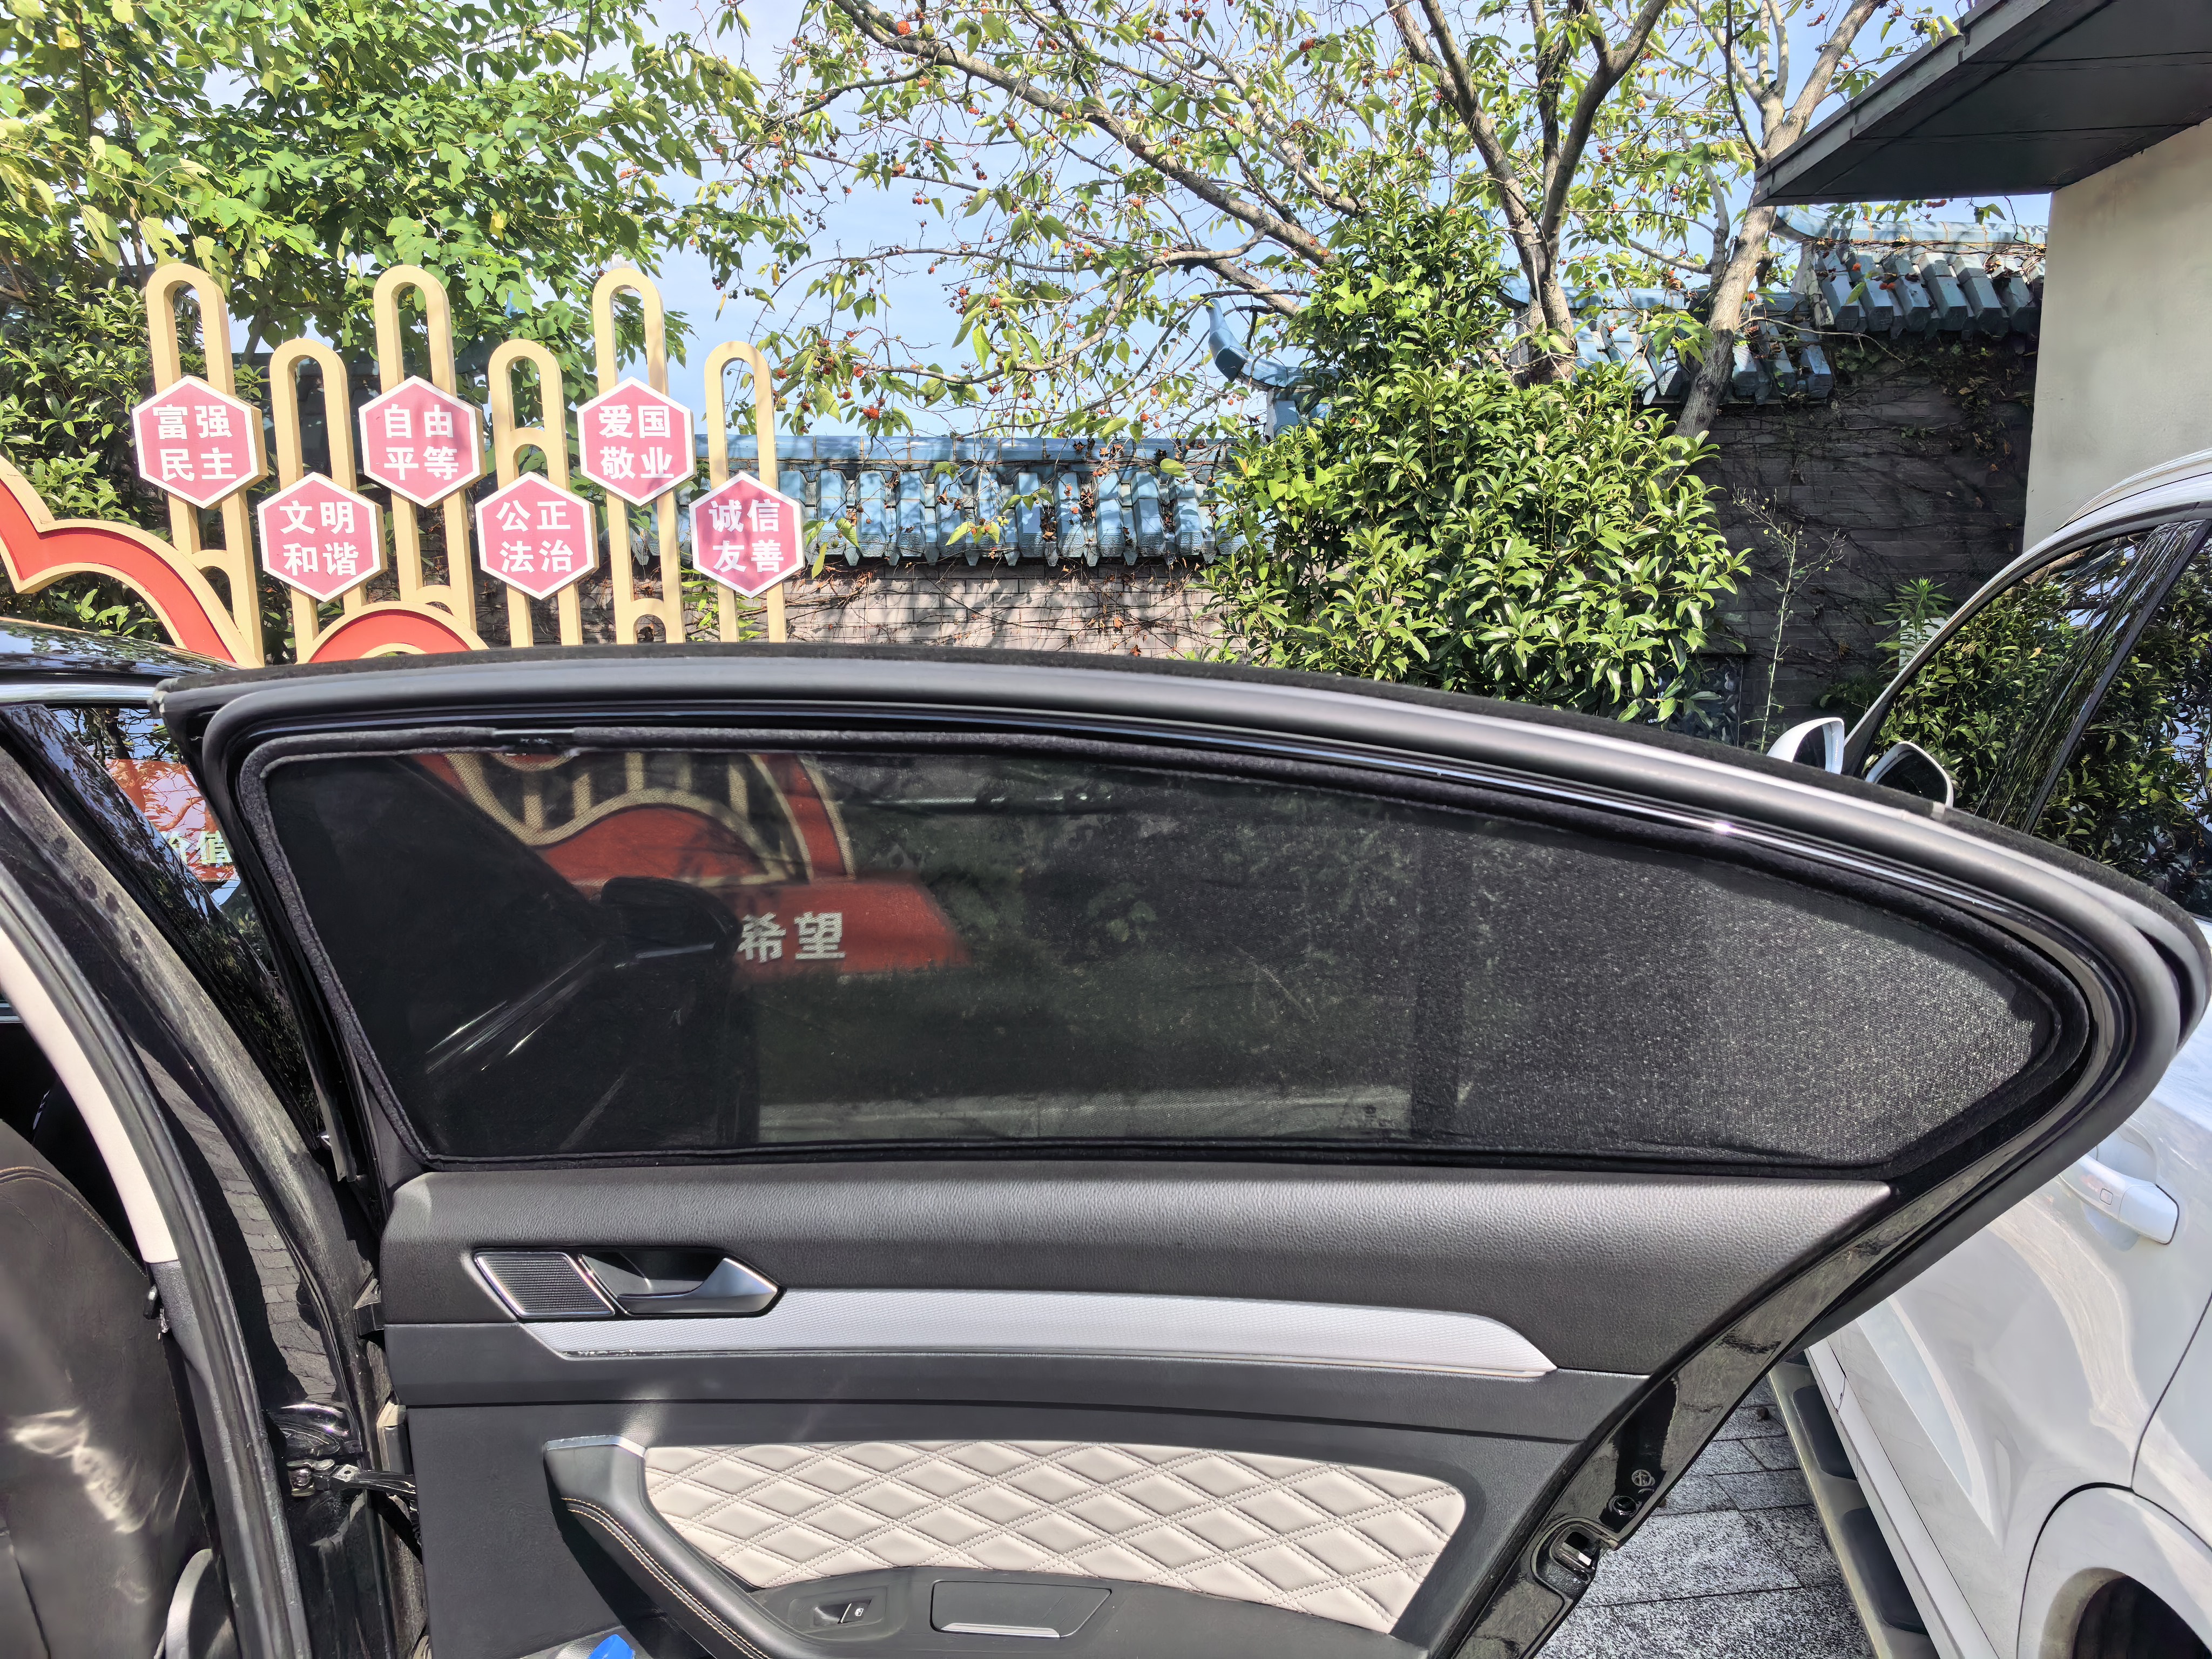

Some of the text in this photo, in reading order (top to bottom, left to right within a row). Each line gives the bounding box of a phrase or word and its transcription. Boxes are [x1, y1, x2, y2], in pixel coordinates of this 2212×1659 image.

[152, 404, 232, 439] 富强
[385, 403, 453, 438] 自由
[599, 404, 670, 438] 爱国
[160, 447, 237, 482] 民主
[384, 446, 458, 480] 平等
[600, 446, 674, 480] 敬业
[279, 500, 354, 534] 文明
[496, 500, 570, 531] 公正
[709, 499, 780, 532] 诚信
[283, 542, 359, 576] 和谐
[500, 539, 573, 572] 法治
[713, 539, 784, 572] 友善
[737, 912, 846, 963] 希望
